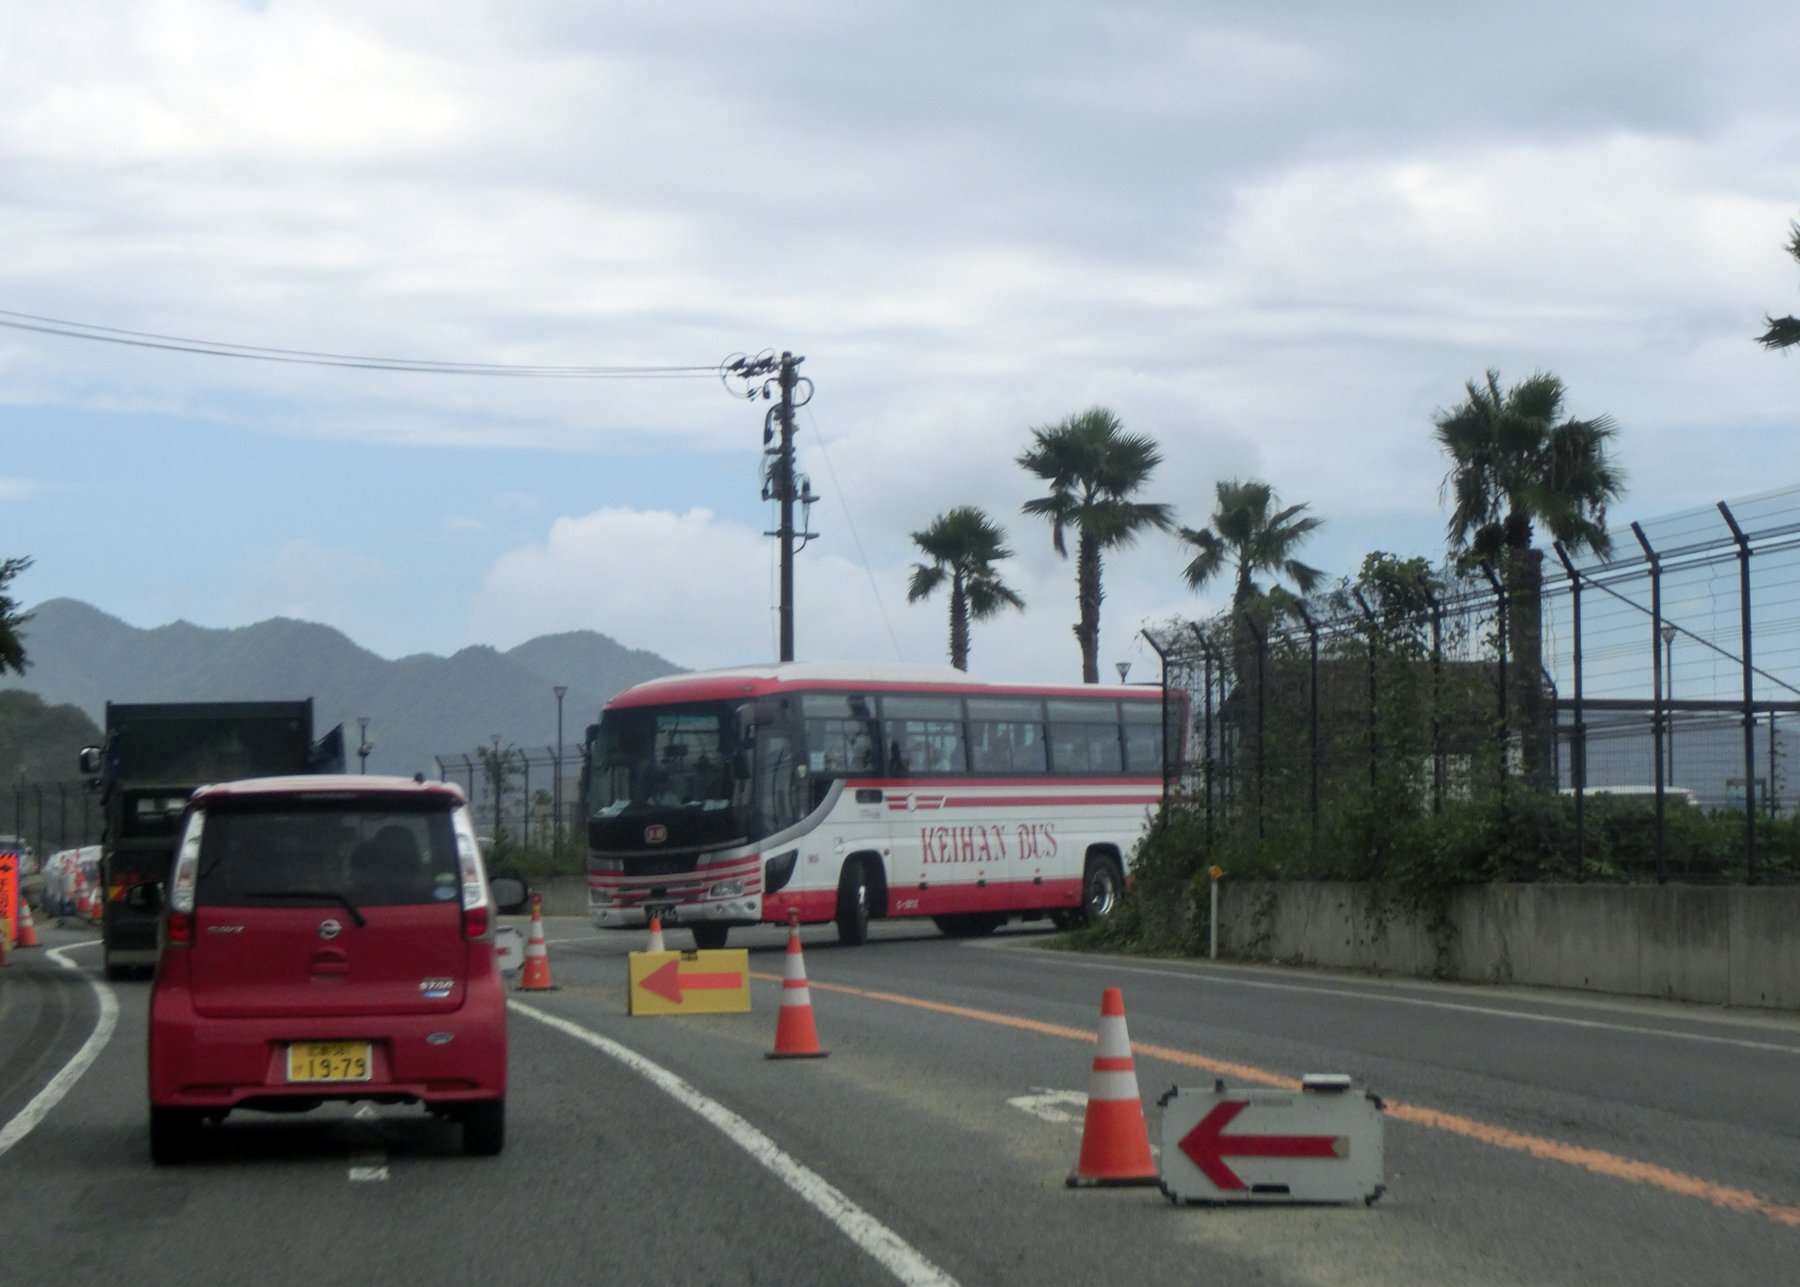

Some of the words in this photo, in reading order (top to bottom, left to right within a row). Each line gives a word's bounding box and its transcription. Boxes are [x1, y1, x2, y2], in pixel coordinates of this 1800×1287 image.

[920, 825, 1006, 864] KEIHAN
[1018, 823, 1057, 860] BUS
[309, 1058, 366, 1078] 19-79
